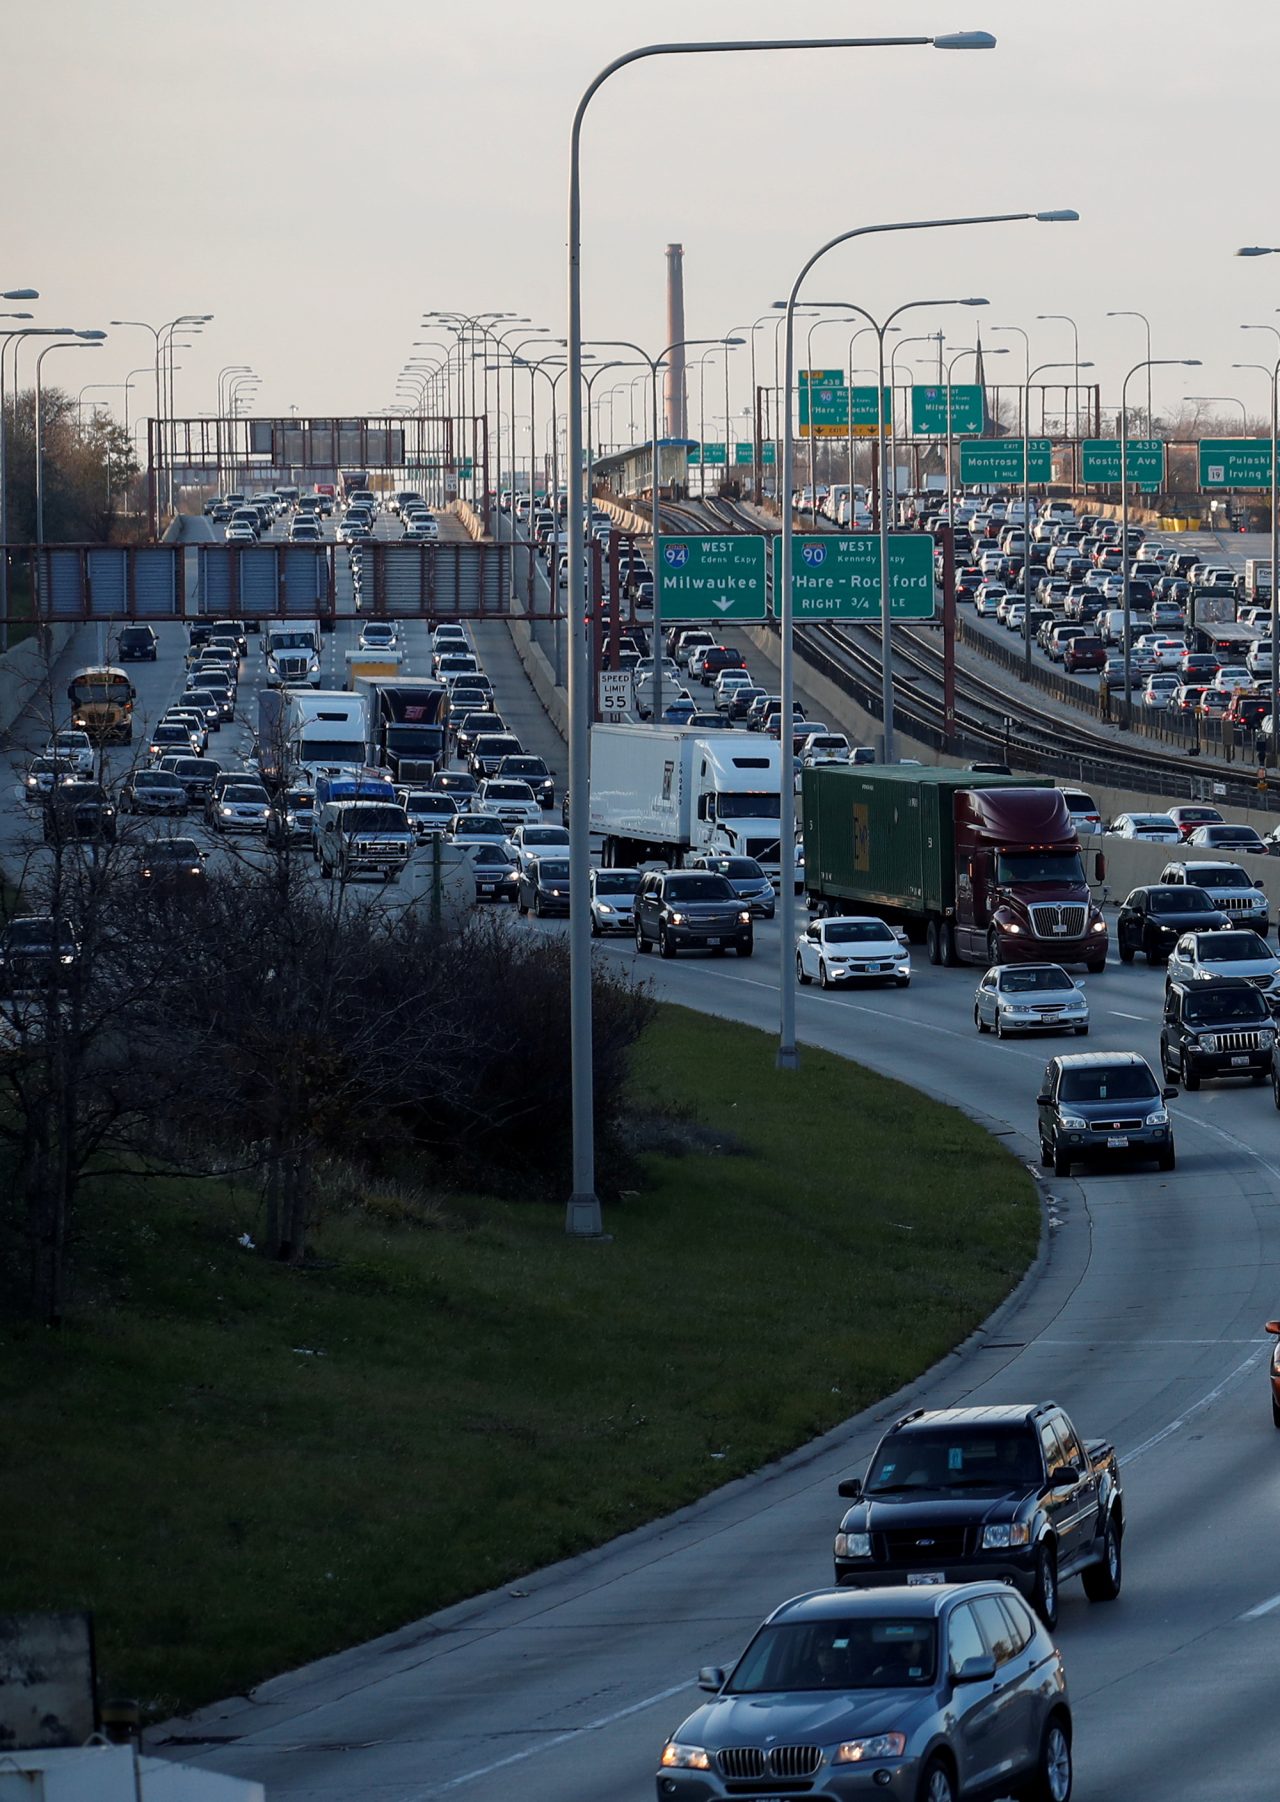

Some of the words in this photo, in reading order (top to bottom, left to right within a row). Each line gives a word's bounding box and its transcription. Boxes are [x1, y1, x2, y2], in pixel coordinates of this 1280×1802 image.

[1027, 442, 1046, 450] 3C
[1136, 442, 1158, 450] 43D
[968, 458, 1018, 466] Montrose
[1229, 456, 1270, 464] Pulaski
[1211, 472, 1220, 480] 19
[1229, 469, 1261, 479] Irving
[702, 542, 734, 552] WEST
[839, 541, 873, 551] WEST
[666, 550, 686, 563] 94
[701, 556, 728, 564] Edens
[734, 556, 757, 565] Expy
[803, 549, 824, 563] 90
[837, 556, 877, 565] Kennedy
[887, 556, 905, 565] xpy
[663, 576, 758, 589] Milwaukee
[782, 575, 834, 588] 'Hare
[802, 599, 842, 609] RIGHT
[850, 597, 870, 609] 3/4
[878, 598, 906, 608] LE
[604, 696, 627, 708] 55
